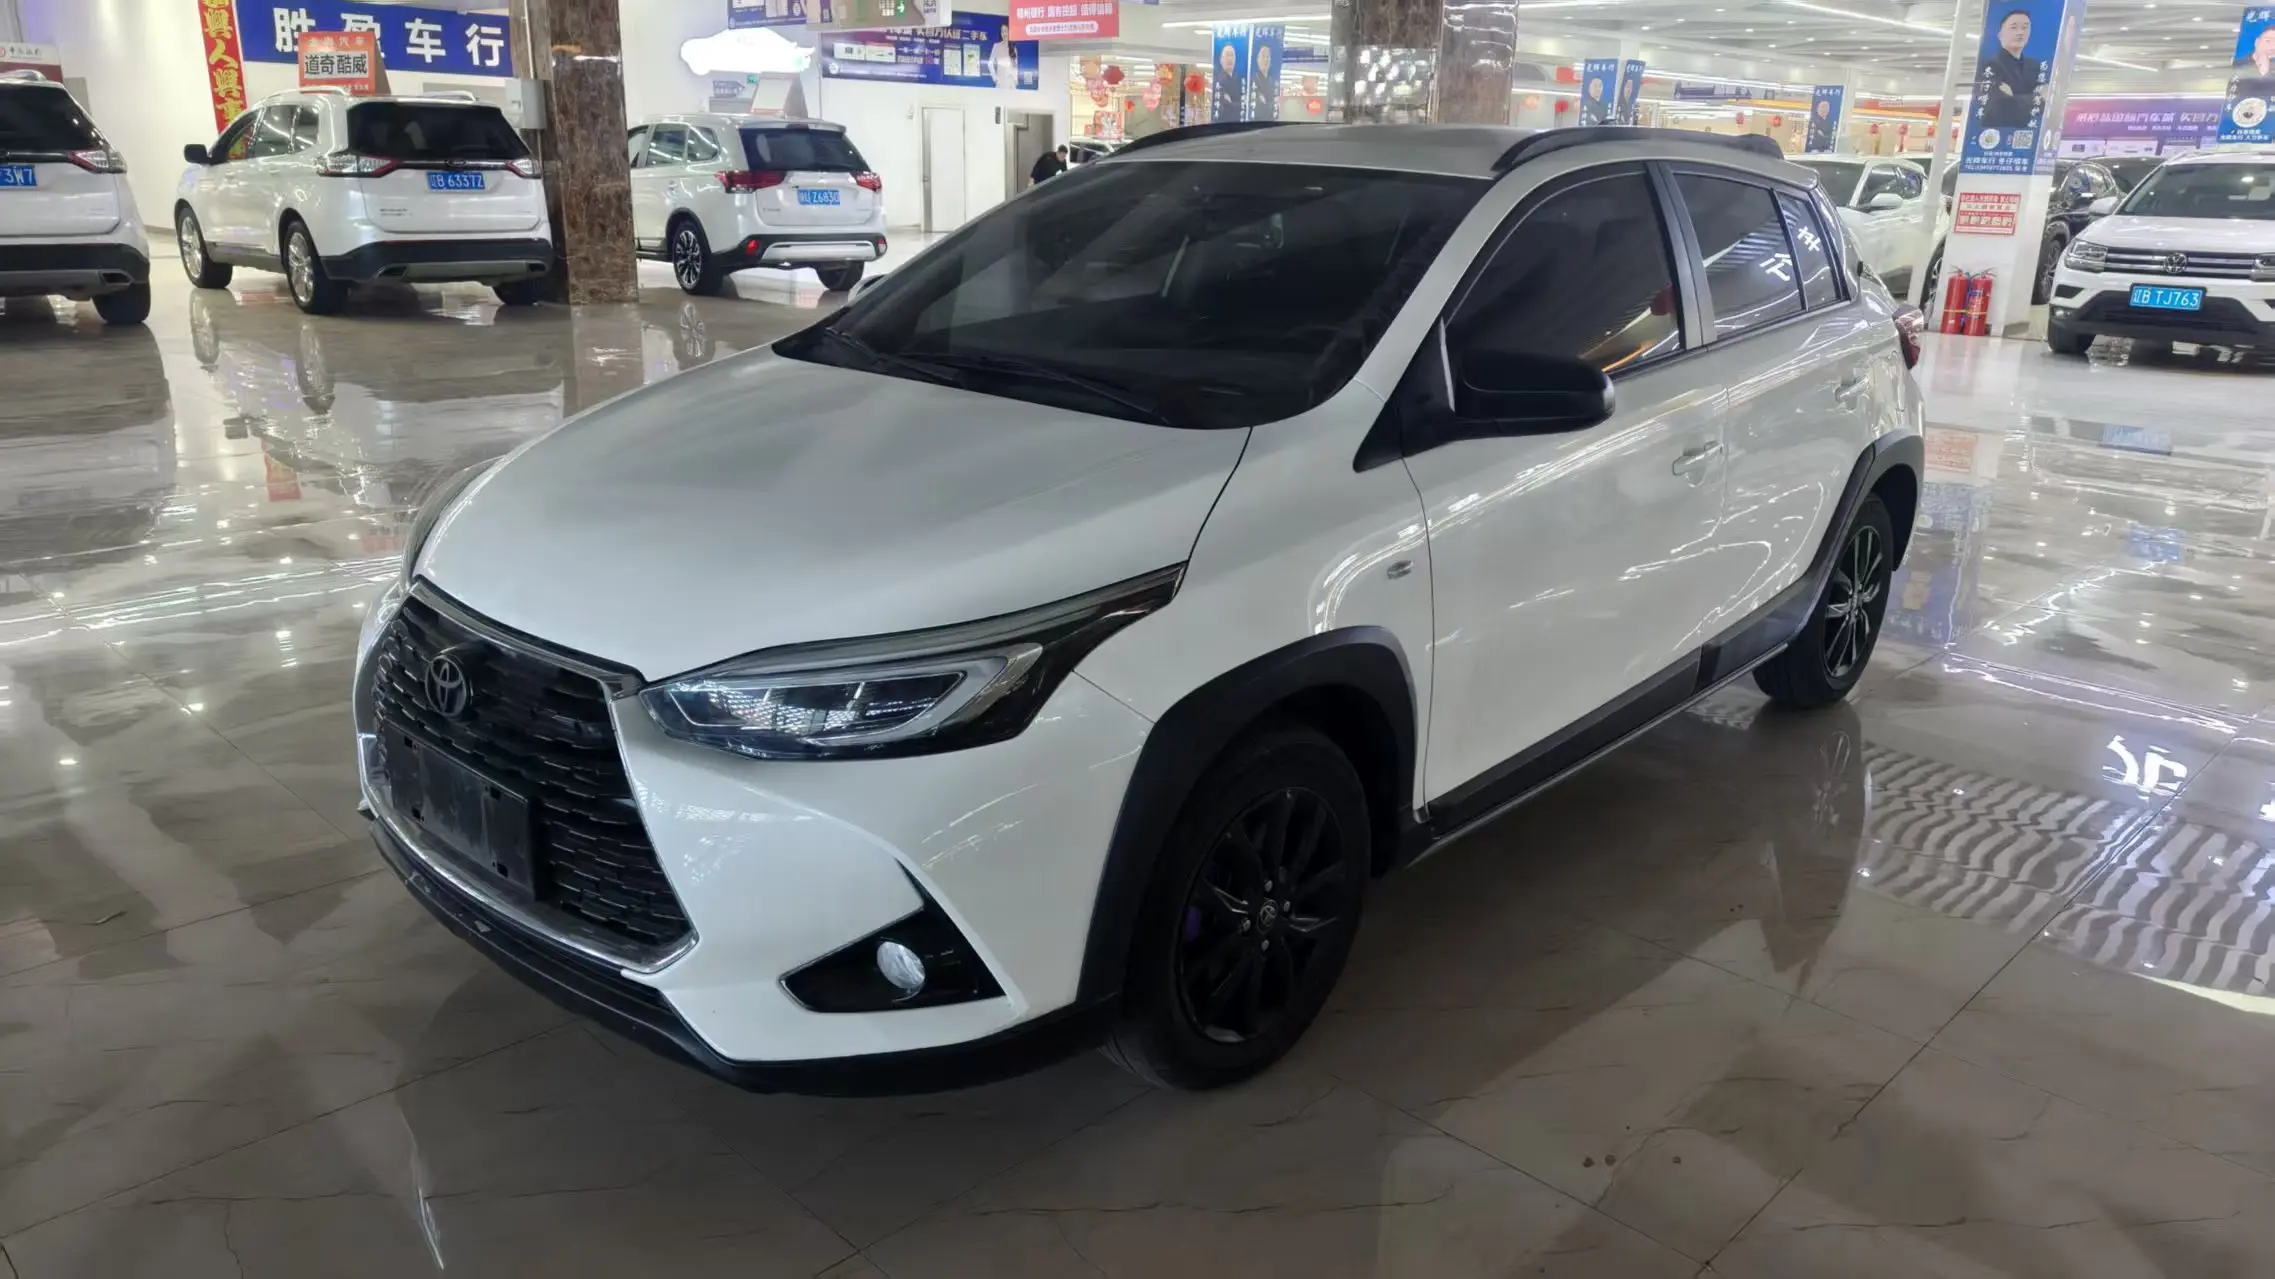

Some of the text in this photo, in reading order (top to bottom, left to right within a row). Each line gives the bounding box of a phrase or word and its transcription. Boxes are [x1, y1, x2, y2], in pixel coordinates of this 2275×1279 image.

[305, 53, 367, 75] 道奇酷威
[0, 168, 33, 185] 3W7
[2132, 289, 2199, 307] 辽B TJ763
